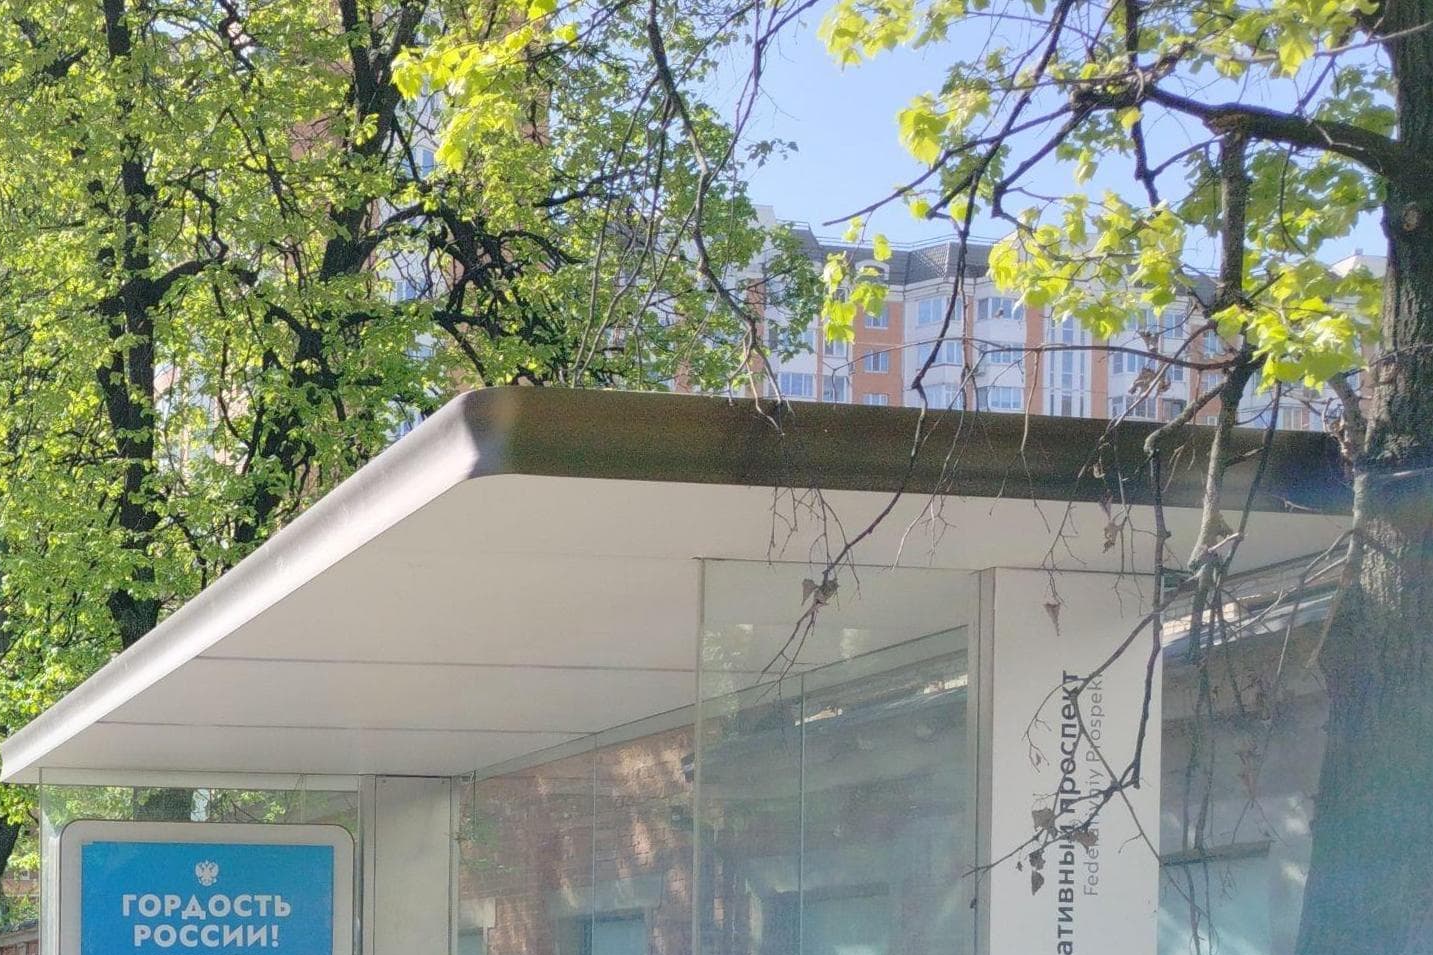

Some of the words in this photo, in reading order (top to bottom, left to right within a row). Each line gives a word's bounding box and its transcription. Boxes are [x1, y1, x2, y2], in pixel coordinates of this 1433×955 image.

[1086, 671, 1105, 762] Prospek
[122, 894, 291, 920] ГОРДОСТЬ
[134, 924, 279, 948] РОССИИ!
